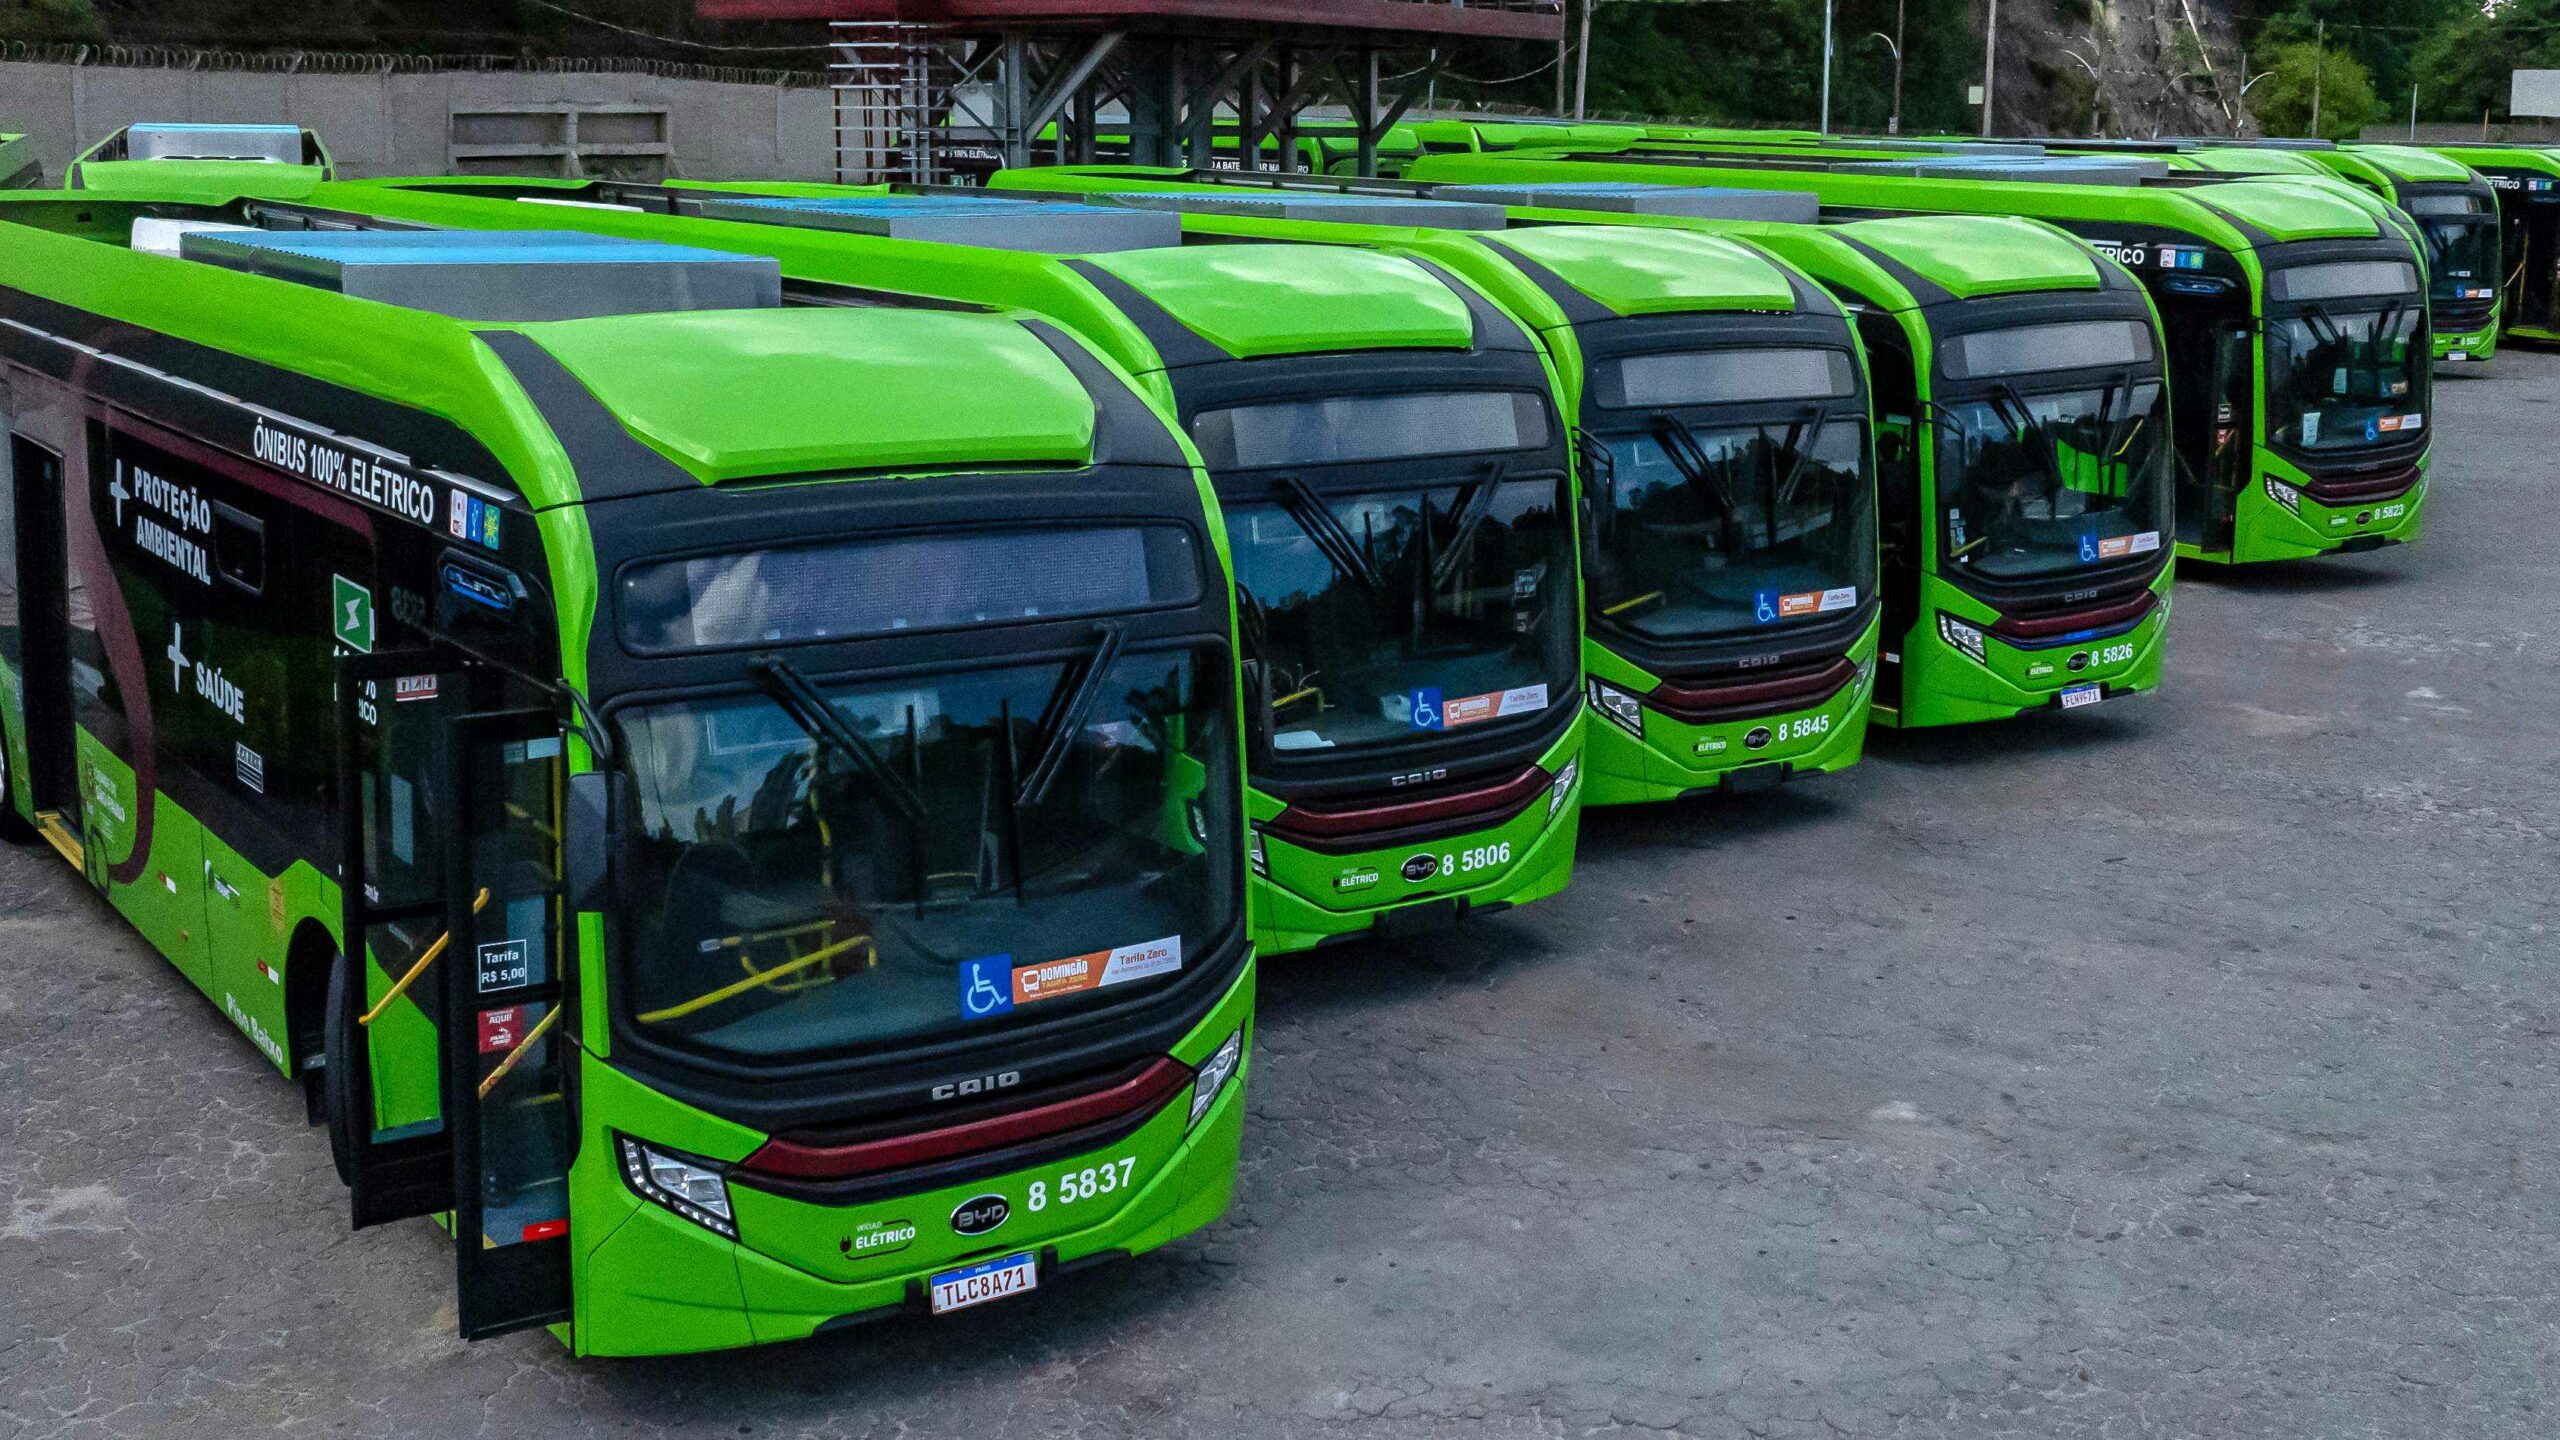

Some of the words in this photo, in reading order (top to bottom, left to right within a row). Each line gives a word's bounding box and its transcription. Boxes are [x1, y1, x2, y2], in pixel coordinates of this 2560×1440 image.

[254, 417, 306, 474] ÔNIBUS
[310, 444, 347, 490] 100%
[350, 457, 434, 524] ELÉTRICO
[134, 466, 211, 534] PROTEÇÃO
[136, 515, 211, 586] AMBIENTAL
[2091, 650, 2099, 667] 8
[2103, 643, 2133, 664] 5826
[196, 662, 244, 724] SAÚDE
[1778, 723, 1788, 742] 8
[1792, 714, 1829, 739] 5845
[1391, 769, 1447, 787] CAIO
[1406, 862, 1436, 875] BYD
[1442, 854, 1454, 876] 8
[1461, 842, 1511, 872] 5806
[1341, 873, 1379, 887] ELÉTRICO
[484, 950, 519, 964] Tarifa
[1119, 953, 1146, 966] Tarifa
[1147, 948, 1168, 960] Zero
[481, 971, 497, 983] R$
[501, 967, 525, 981] 5,00
[1040, 959, 1088, 982] DOMINGÃO
[932, 1070, 1021, 1100] CAIO
[1027, 1181, 1047, 1212] 8
[1058, 1156, 1136, 1204] 5837
[958, 1204, 1005, 1227] BYD
[855, 1226, 916, 1250] ELÉTRICO
[943, 1266, 1026, 1306] TLC8A71
